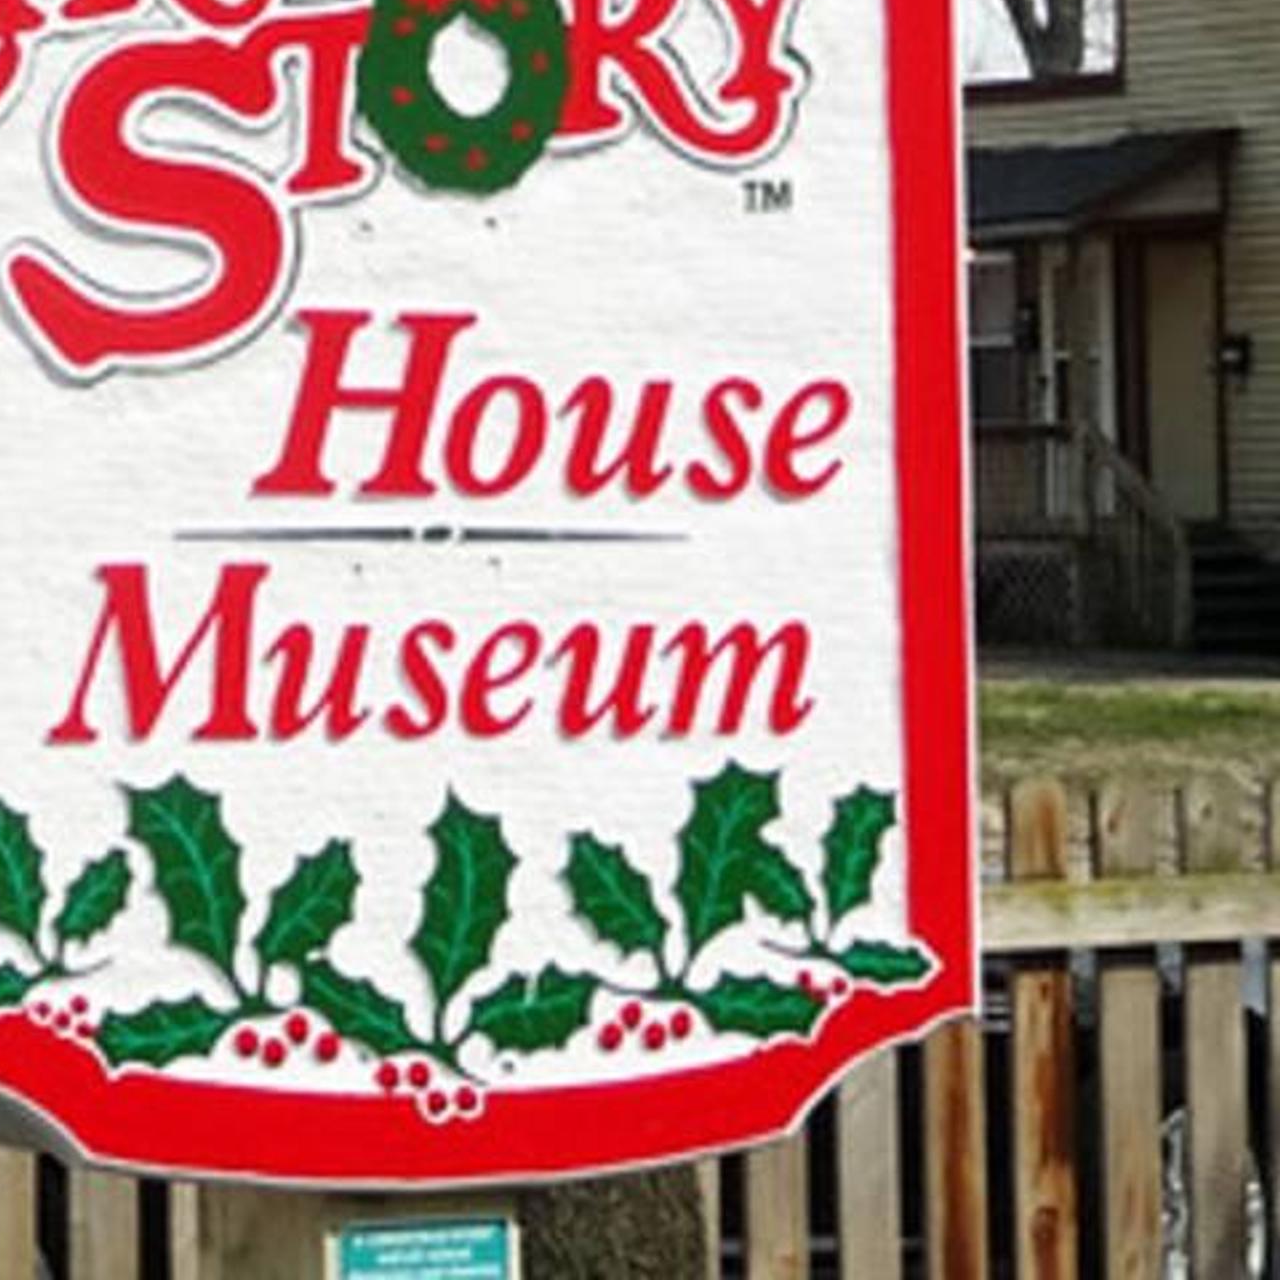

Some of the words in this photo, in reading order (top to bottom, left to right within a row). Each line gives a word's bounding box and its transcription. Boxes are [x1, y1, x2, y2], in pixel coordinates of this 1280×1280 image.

[741, 180, 794, 212] TM
[250, 308, 852, 502] House
[44, 562, 816, 746] Museum
